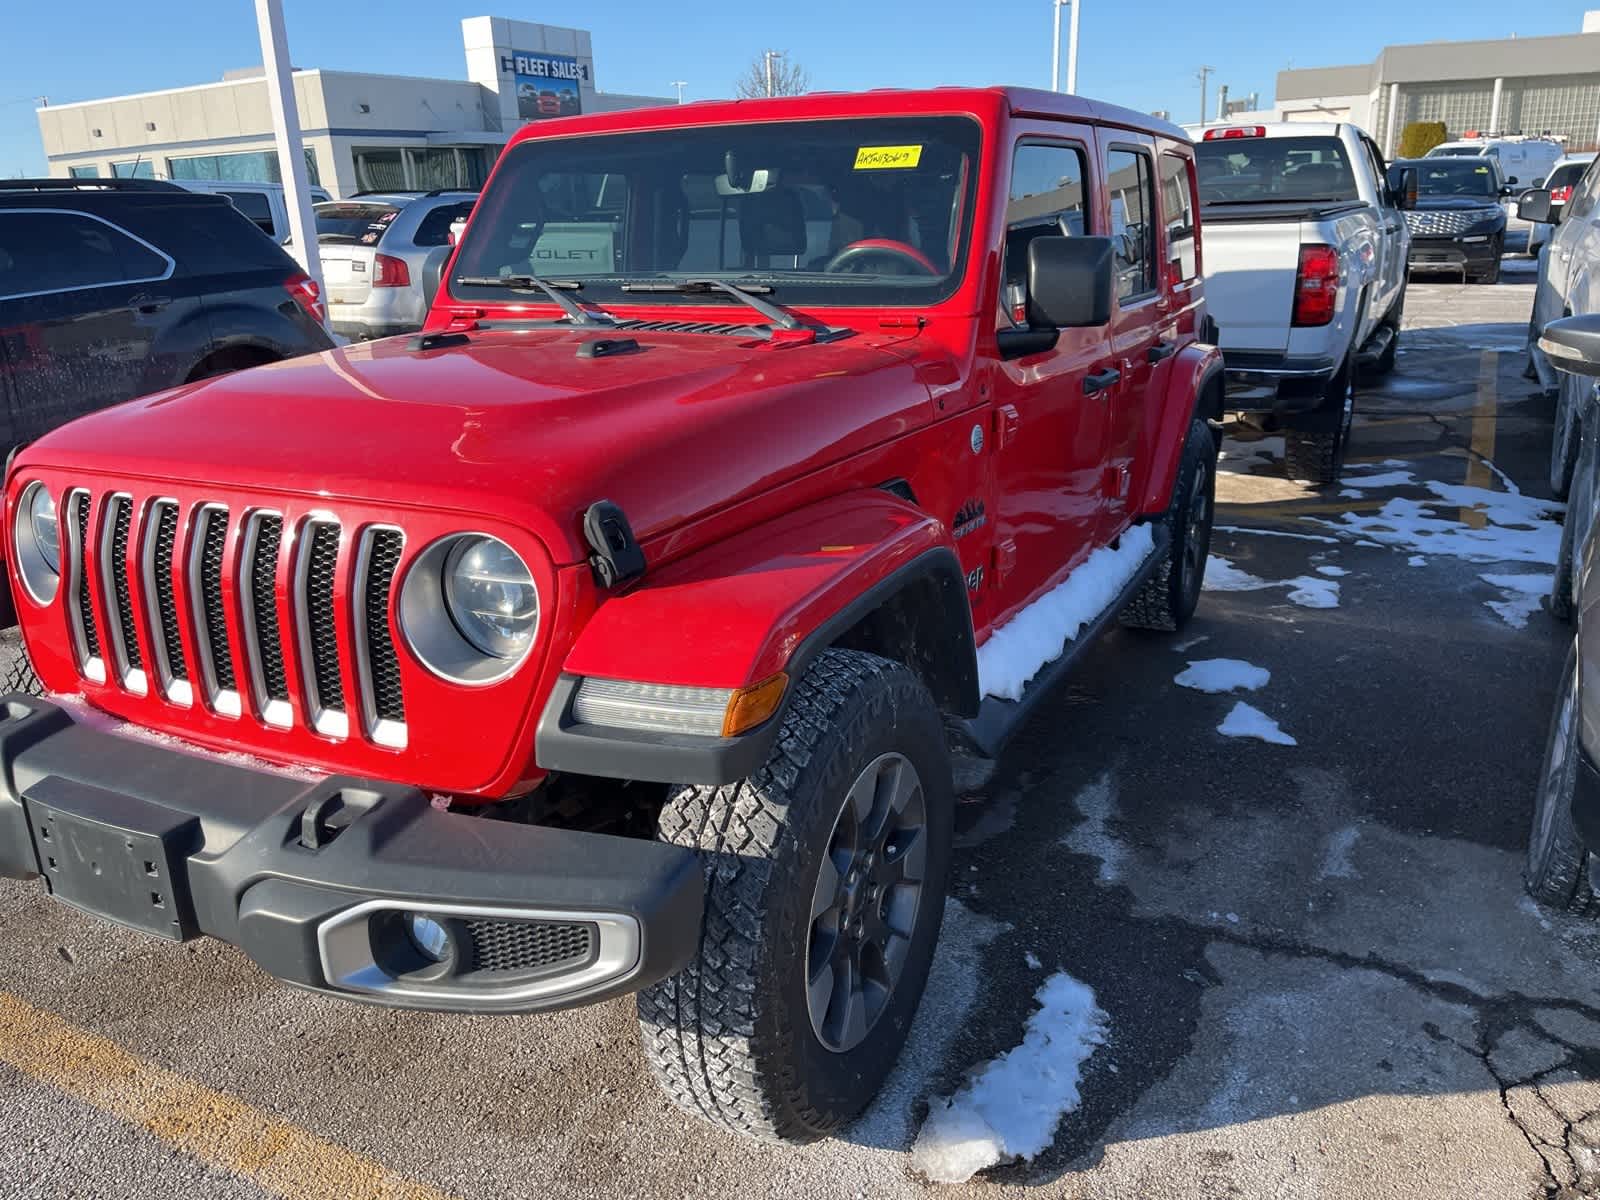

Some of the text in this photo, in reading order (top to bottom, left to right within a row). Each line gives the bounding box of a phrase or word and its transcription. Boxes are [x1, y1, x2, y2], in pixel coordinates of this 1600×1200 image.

[514, 56, 584, 80] FLEET SALES
[529, 249, 599, 260] OLET
